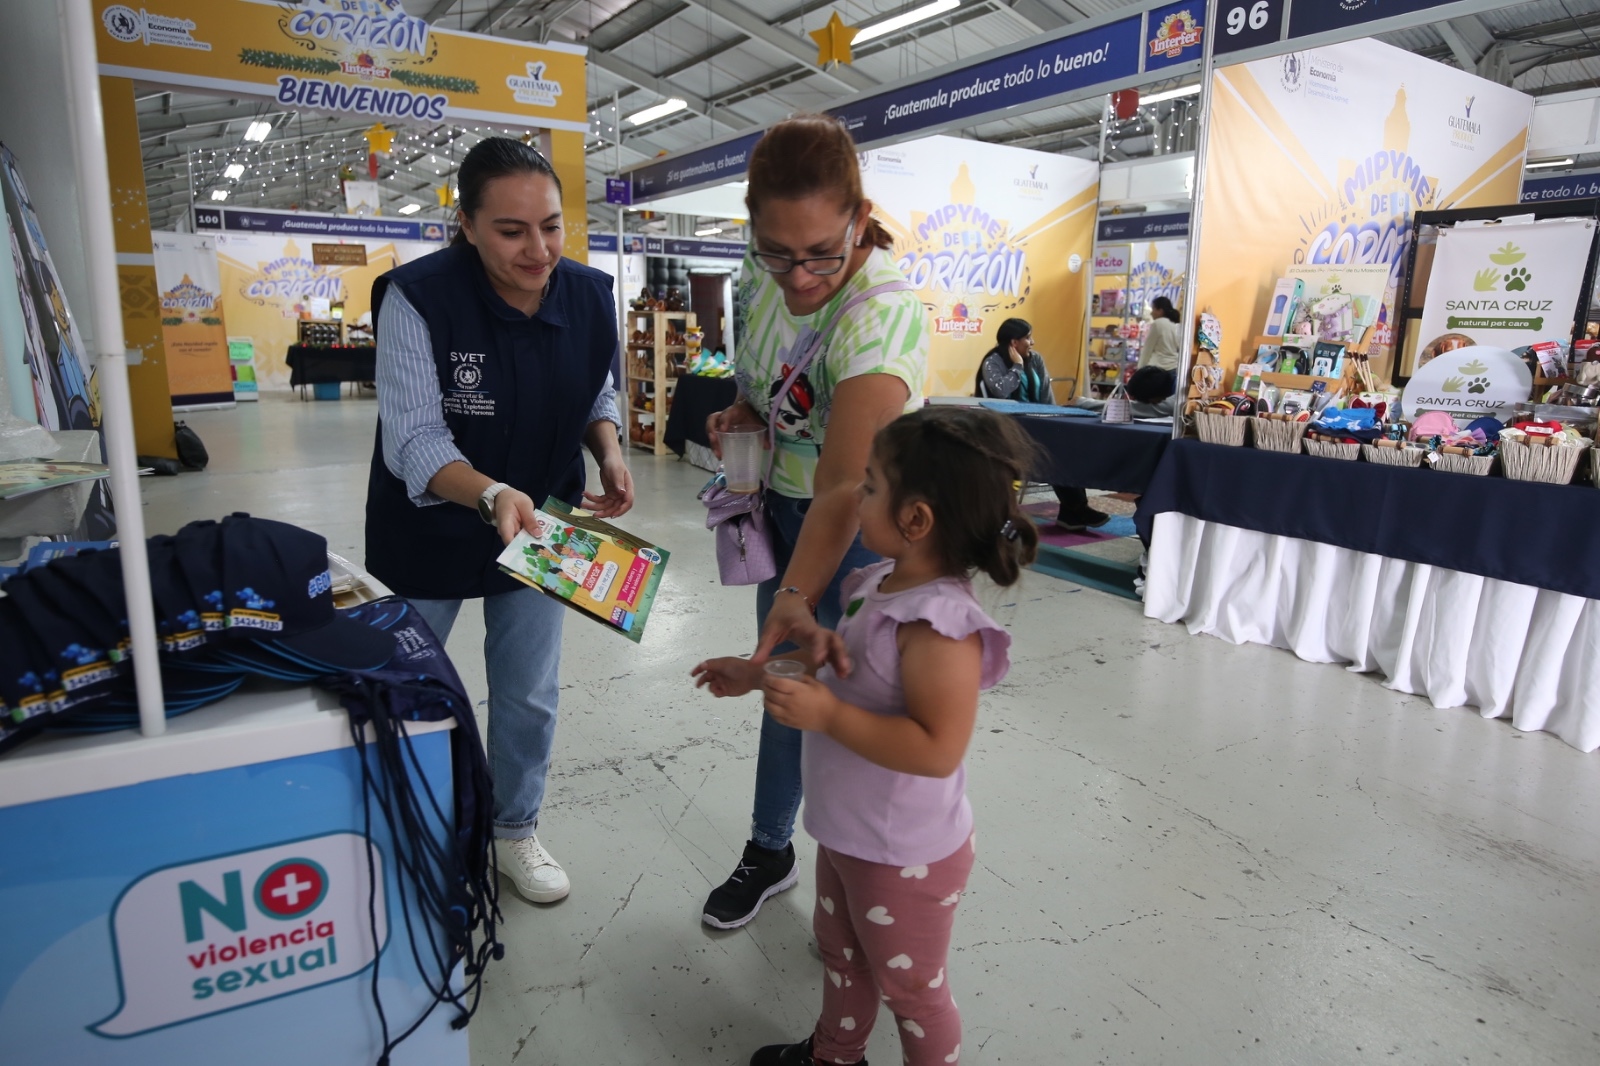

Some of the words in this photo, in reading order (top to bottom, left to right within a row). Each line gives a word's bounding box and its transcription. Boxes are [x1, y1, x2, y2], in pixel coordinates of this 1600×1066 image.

[341, 1, 358, 11] DE
[1339, 0, 1367, 11] GUATEMAL
[147, 15, 184, 27] Ministerio
[184, 20, 194, 28] de
[1226, 0, 1269, 36] 96
[148, 23, 187, 34] Economía
[289, 10, 430, 56] CORAZÓN
[1154, 31, 1197, 52] Interfer
[345, 62, 387, 77] Interfer
[1310, 55, 1337, 71] Ministerio
[1337, 63, 1344, 73] de
[1309, 67, 1337, 82] Economía
[509, 78, 559, 92] GUATEMALA
[884, 89, 948, 125] ¡Guatemala
[949, 77, 1000, 108] produce
[1002, 67, 1034, 89] todo
[1036, 62, 1051, 80] lo
[1054, 43, 1109, 74] bueno!
[278, 77, 446, 120] BIENVENIDOS
[1448, 115, 1481, 135] GUATEMALA
[674, 170, 679, 179] es
[717, 157, 725, 170] es
[726, 151, 746, 168] bueno!
[1014, 178, 1048, 191] GUATEMALA
[1344, 149, 1431, 207] MIPYME
[1541, 185, 1571, 199] todo
[1573, 184, 1586, 196] lo
[1370, 191, 1388, 217] DE
[198, 215, 219, 224] 100
[282, 220, 327, 231] ¡Guatemala
[328, 222, 358, 233] produce
[359, 224, 376, 233] todo
[377, 225, 384, 234] lo
[385, 225, 410, 235] bueno!
[918, 203, 1002, 241] MIPYME
[943, 231, 960, 248] DE
[1306, 219, 1412, 288] CORAZ
[263, 256, 322, 275] MIPYME
[896, 241, 1026, 298] CORAZÓN
[249, 275, 342, 300] CORAZÓN
[162, 295, 214, 309] CORAZÓN
[1445, 300, 1500, 311] SANTA
[1504, 300, 1553, 311] CRUZ
[938, 316, 980, 333] Interfer
[1458, 319, 1489, 328] natural
[1491, 320, 1506, 328] pet
[450, 352, 486, 363] SVET
[1415, 396, 1462, 407] SANTA
[1465, 399, 1506, 410] CRUZ
[570, 559, 584, 578] Libro
[586, 565, 602, 589] colorear
[233, 617, 279, 630] 3424-5130
[187, 920, 335, 970] violencia
[192, 936, 337, 1000] sexual
